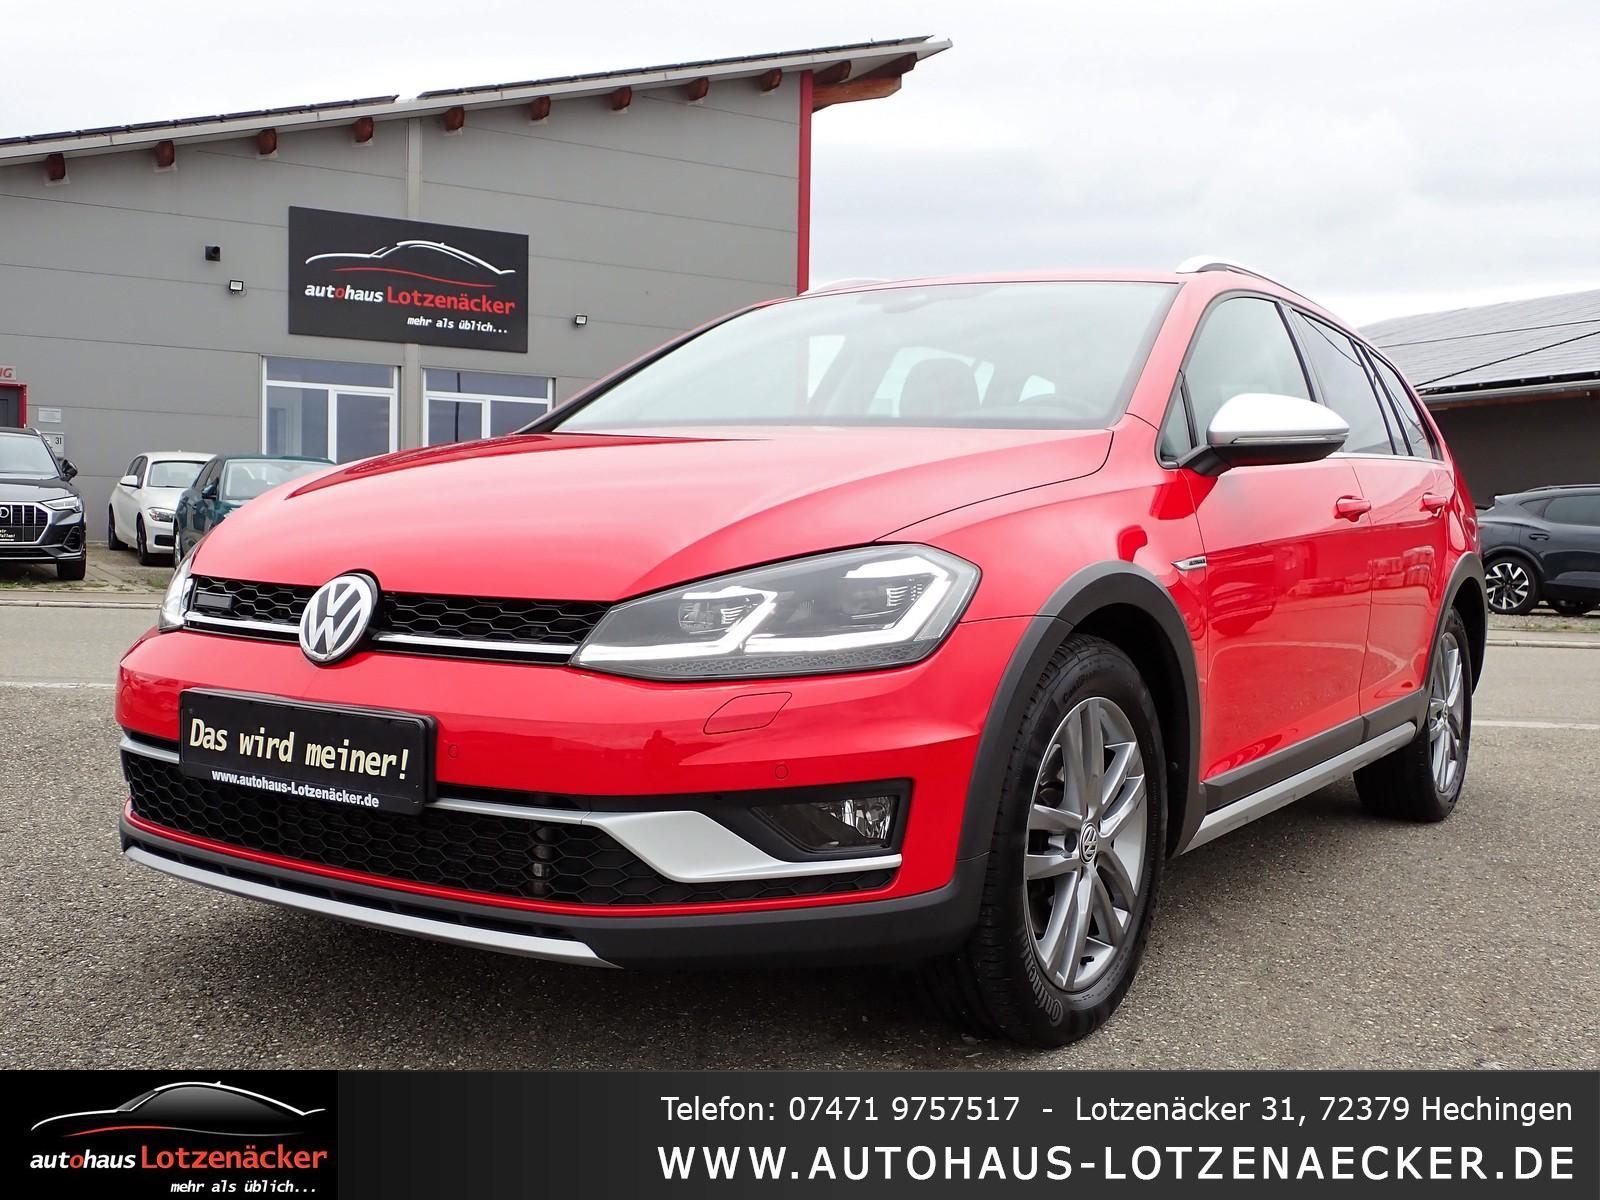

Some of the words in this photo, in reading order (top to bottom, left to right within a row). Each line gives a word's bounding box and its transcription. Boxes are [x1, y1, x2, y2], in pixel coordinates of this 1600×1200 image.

[304, 283, 384, 303] autohaus
[386, 286, 516, 315] Lotzenäcker
[407, 316, 432, 327] mehr
[436, 318, 454, 329] als
[458, 319, 507, 334] üblich...
[189, 718, 228, 752] Das
[239, 727, 295, 763] wird
[304, 739, 409, 780] meiner!
[211, 770, 380, 808] www.autohaus-Lotzenäcker.de
